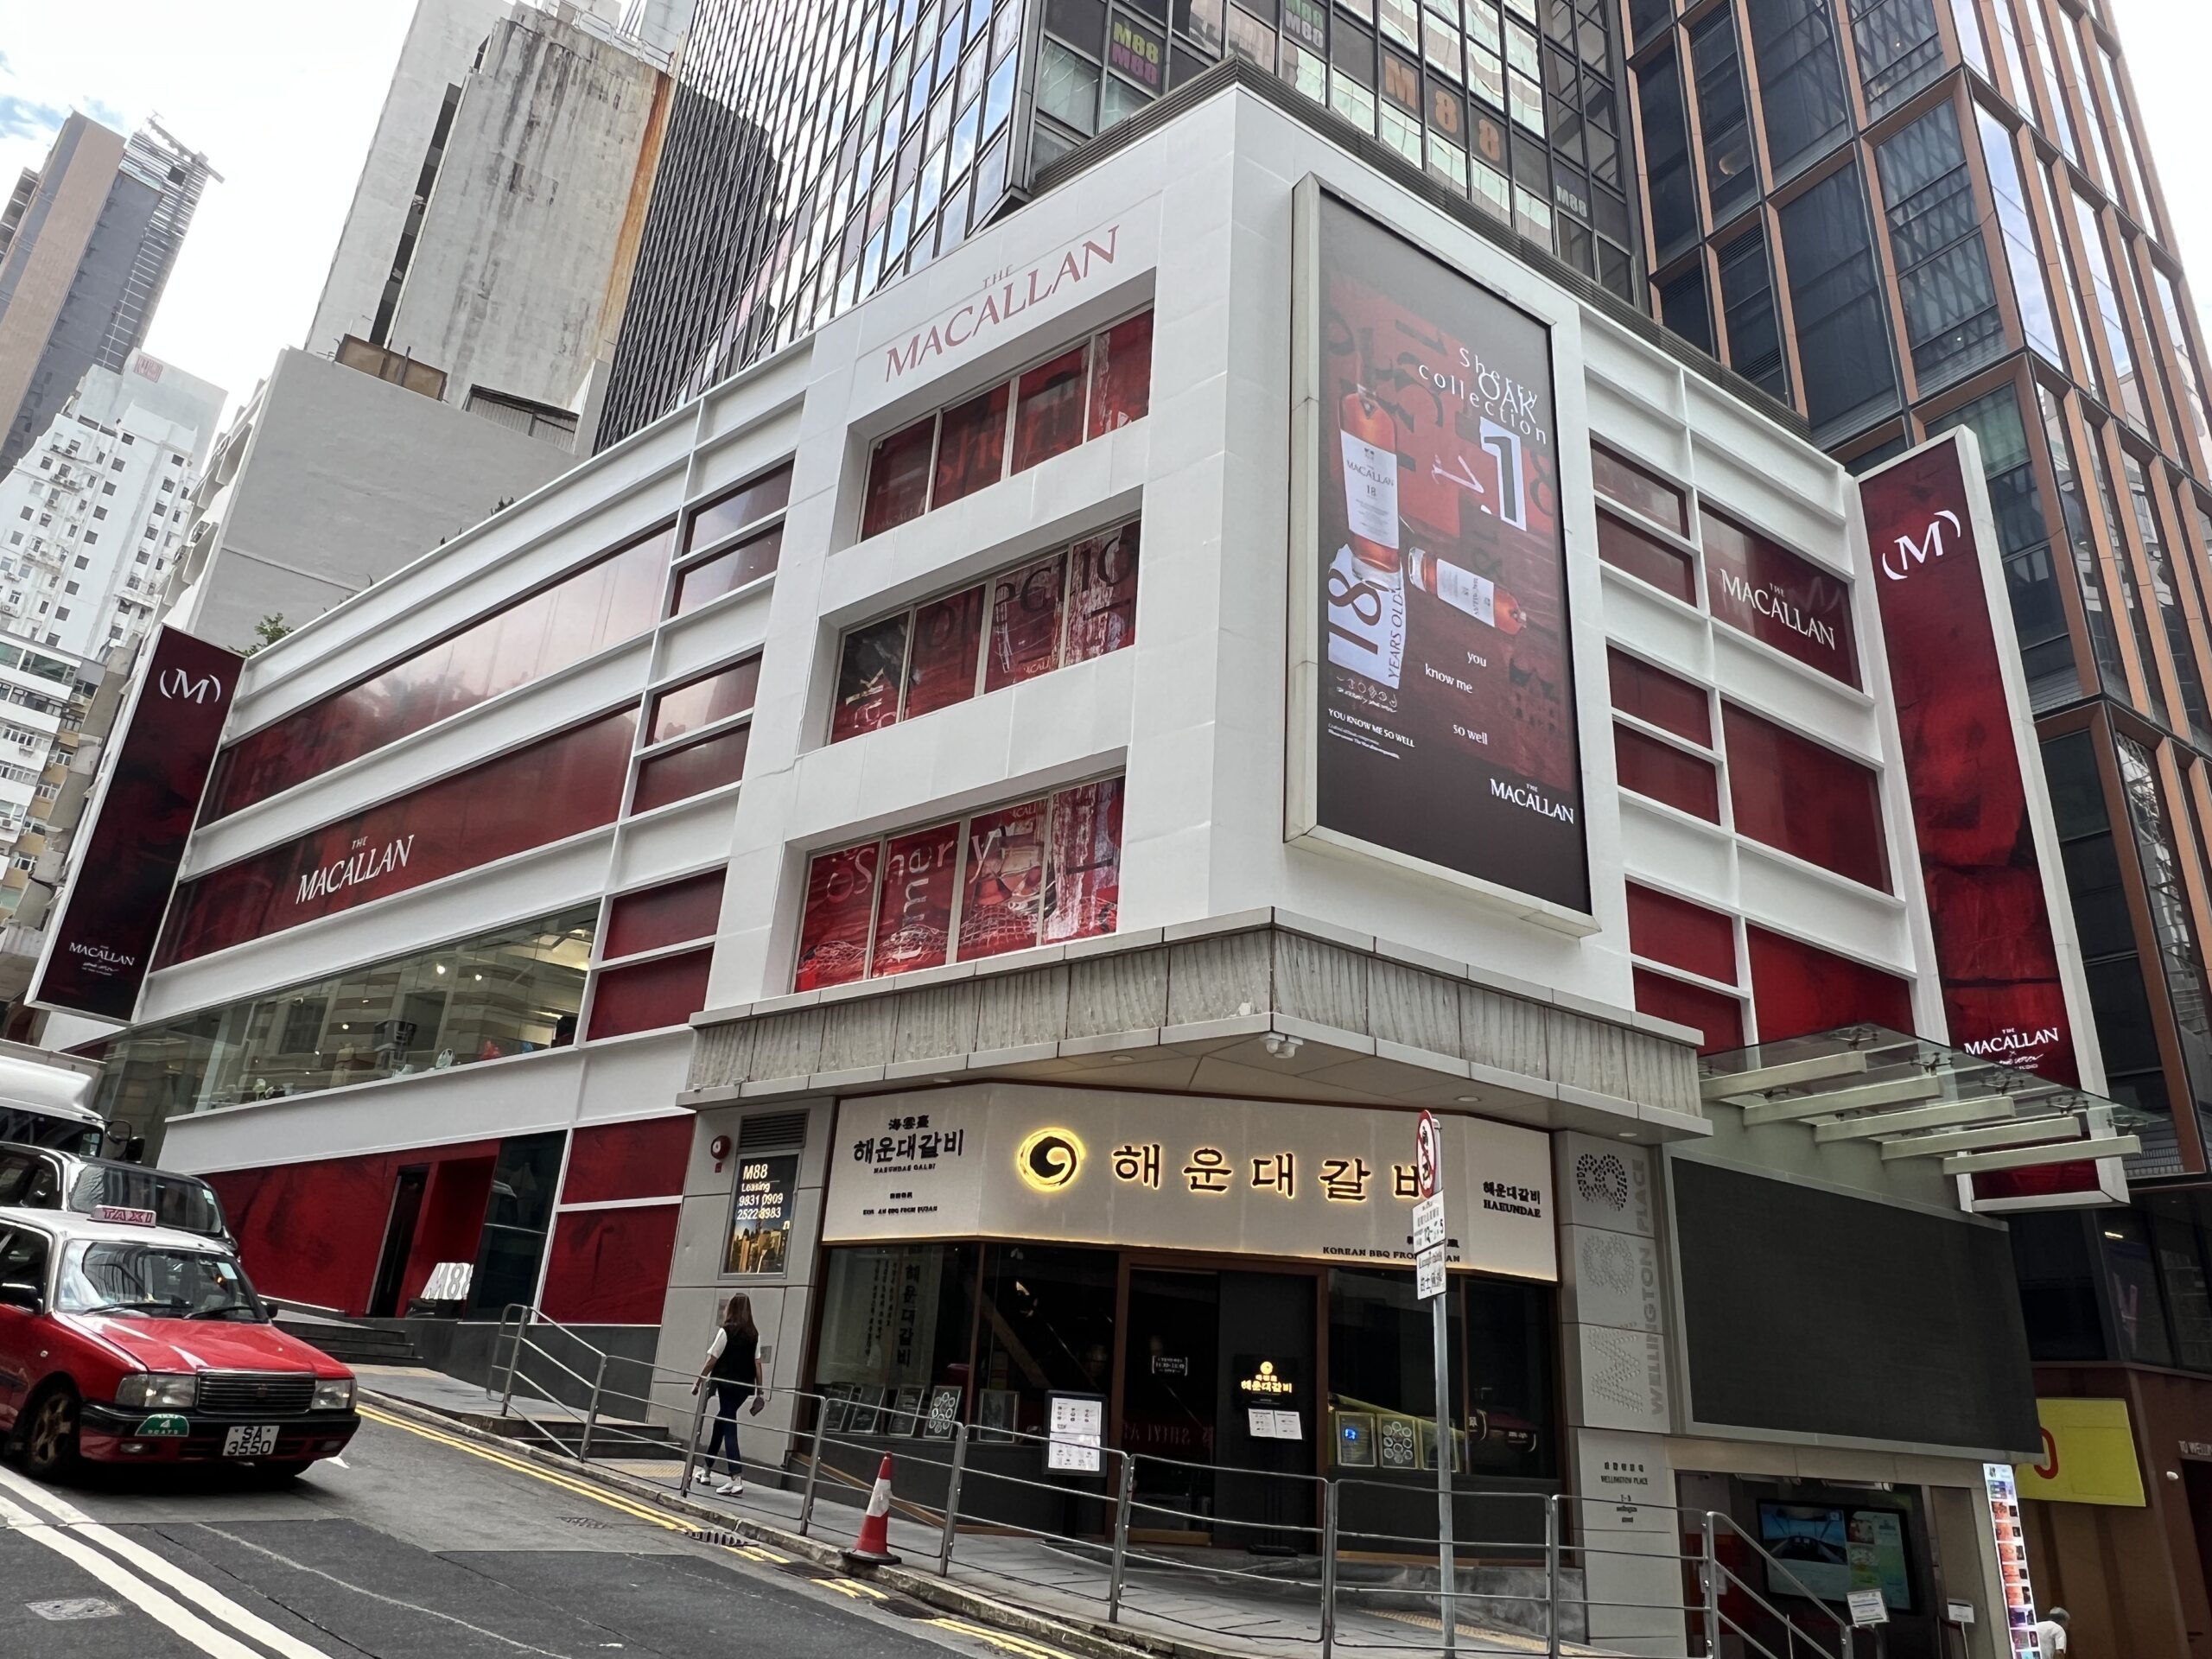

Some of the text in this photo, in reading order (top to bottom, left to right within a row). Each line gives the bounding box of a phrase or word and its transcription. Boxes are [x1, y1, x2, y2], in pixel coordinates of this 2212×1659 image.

[1113, 21, 1159, 64] M88
[982, 264, 1013, 289] THE
[886, 225, 1120, 383] MACALLAN
[1418, 364, 1547, 445] collection
[1770, 582, 1785, 597] THE
[1719, 569, 1836, 651] MACALLAN
[1389, 630, 1402, 678] YEARS
[1467, 651, 1487, 668] you
[1425, 663, 1473, 694] know me
[1328, 708, 1346, 721] YOU
[1346, 715, 1371, 730] KNOW
[1371, 724, 1383, 735] ME
[1383, 728, 1395, 740] SO
[1395, 733, 1415, 747] WELL
[1452, 723, 1488, 746] so well
[1490, 778, 1574, 824] MACALLAN
[352, 836, 368, 849] THE
[296, 834, 415, 905] MACALLAN
[69, 942, 135, 966] MACALLAN
[1964, 1027, 2059, 1055] MACALLAN
[854, 1128, 964, 1164] 해운대갈비
[743, 1163, 768, 1180] M88
[741, 1181, 771, 1193] Leasing
[103, 1208, 153, 1223] TAXI
[736, 1209, 758, 1220] 2522
[1483, 1198, 1541, 1218] HAEUNDAE
[1323, 1246, 1366, 1257] KOREAN
[1370, 1249, 1390, 1258] BBQ
[1393, 1251, 1417, 1260] FRO
[1640, 1247, 1665, 1416] WELLINGTON
[242, 1426, 263, 1442] SA
[227, 1440, 271, 1456] 3550
